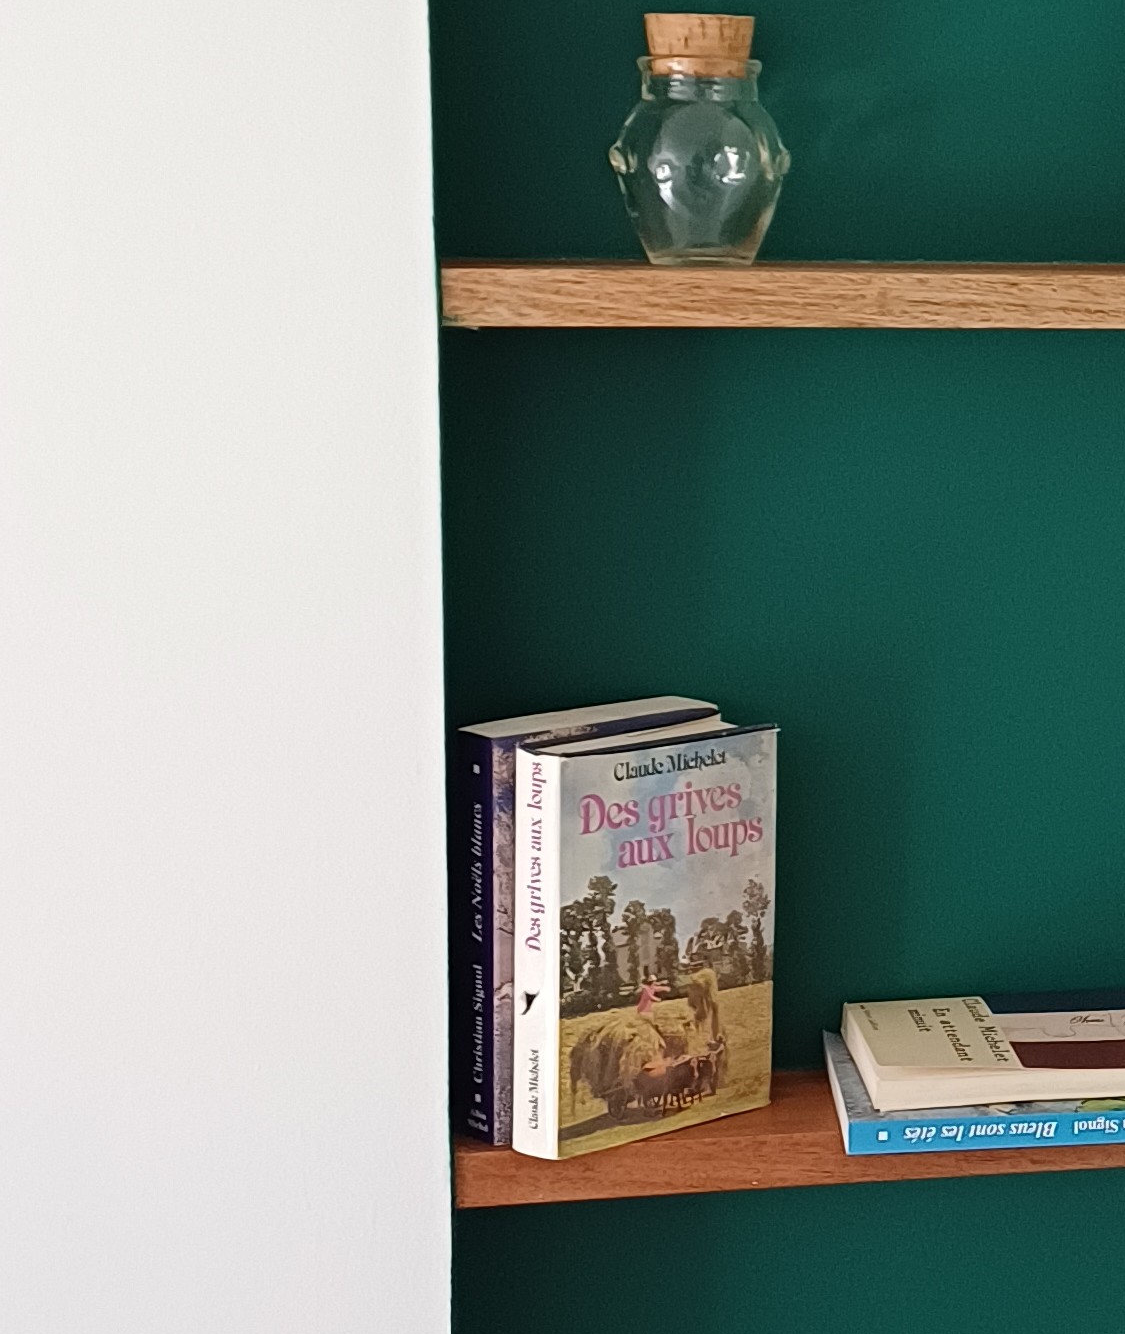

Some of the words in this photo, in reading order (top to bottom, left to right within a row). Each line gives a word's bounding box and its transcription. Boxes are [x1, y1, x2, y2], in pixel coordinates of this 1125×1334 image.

[613, 757, 664, 782] Claude
[666, 749, 727, 772] Michelet
[527, 762, 547, 810] loups
[579, 793, 641, 835] Des
[648, 781, 743, 833] grives
[470, 802, 483, 857] blancs
[531, 817, 543, 852] aux
[617, 833, 675, 868] aux
[686, 816, 764, 857] loups
[526, 857, 546, 915] grives
[471, 914, 483, 943] Les
[525, 918, 542, 951] Des
[932, 1008, 950, 1017] En
[472, 1016, 484, 1084] Christian
[940, 1020, 974, 1062] attendant
[978, 1026, 1010, 1062] Michelet
[529, 1049, 540, 1093] Michelet
[529, 1096, 539, 1130] Claude
[1009, 1121, 1058, 1139] Bleus
[1073, 1116, 1119, 1135] Signol
[903, 1127, 936, 1144] étés
[940, 1125, 964, 1142] les
[968, 1124, 1006, 1138] sont
